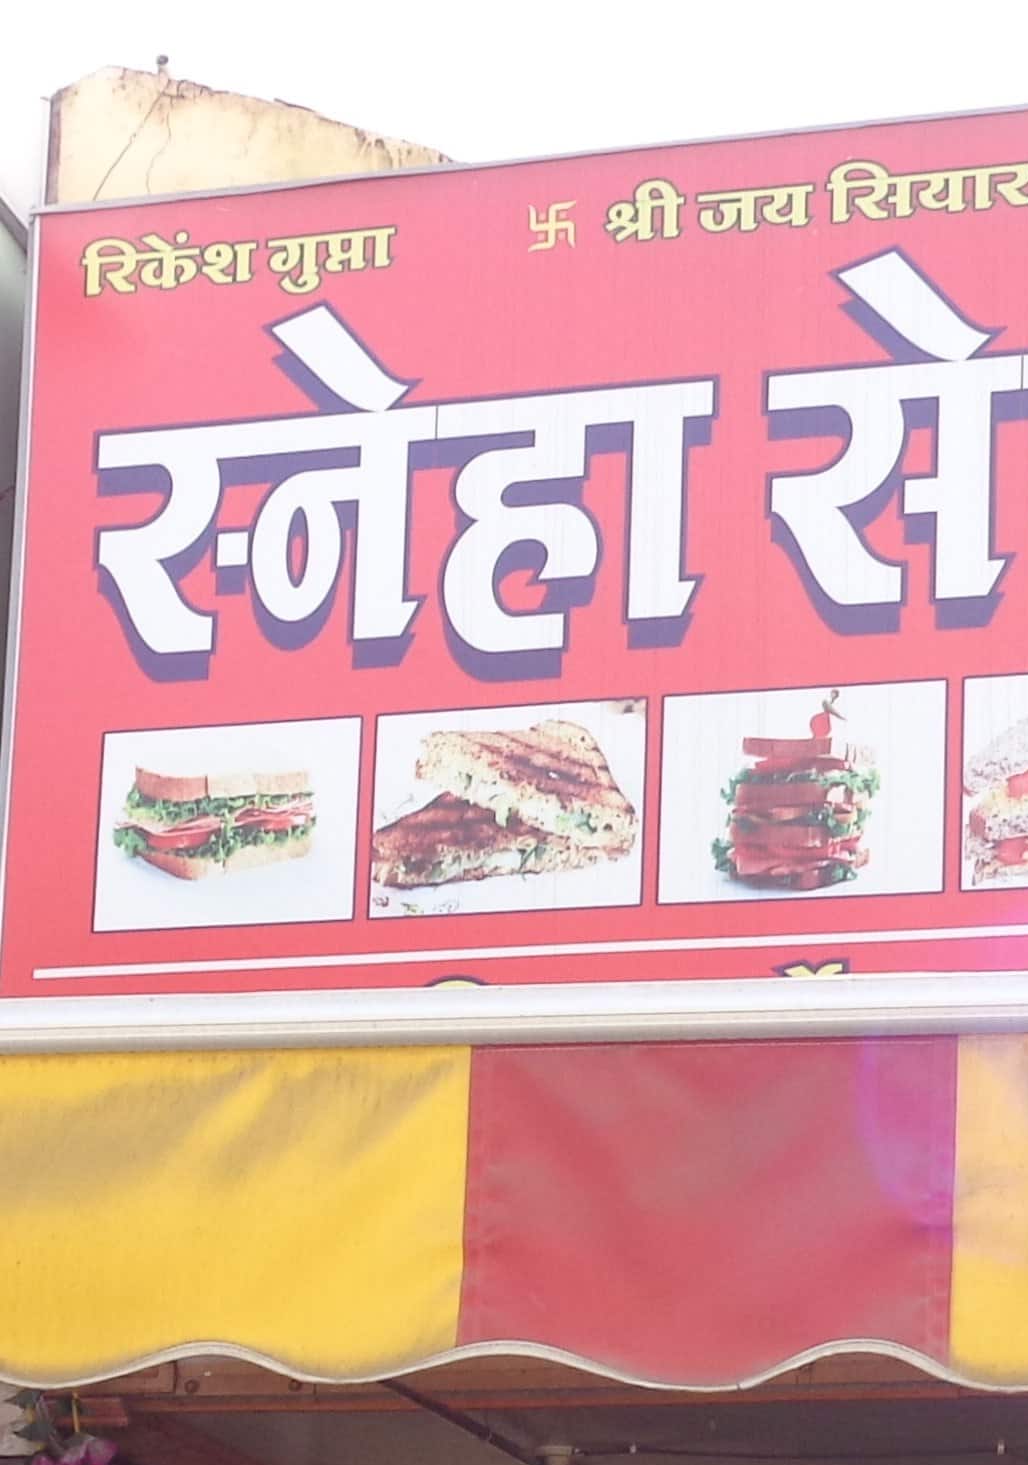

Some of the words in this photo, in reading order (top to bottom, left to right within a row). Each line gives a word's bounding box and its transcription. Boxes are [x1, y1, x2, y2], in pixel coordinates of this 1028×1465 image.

[605, 180, 683, 242] श्री
[697, 183, 811, 233] जय
[82, 230, 258, 296] रिकेंश
[267, 224, 397, 294] गुप्ता
[94, 301, 717, 683] स्नेहा
